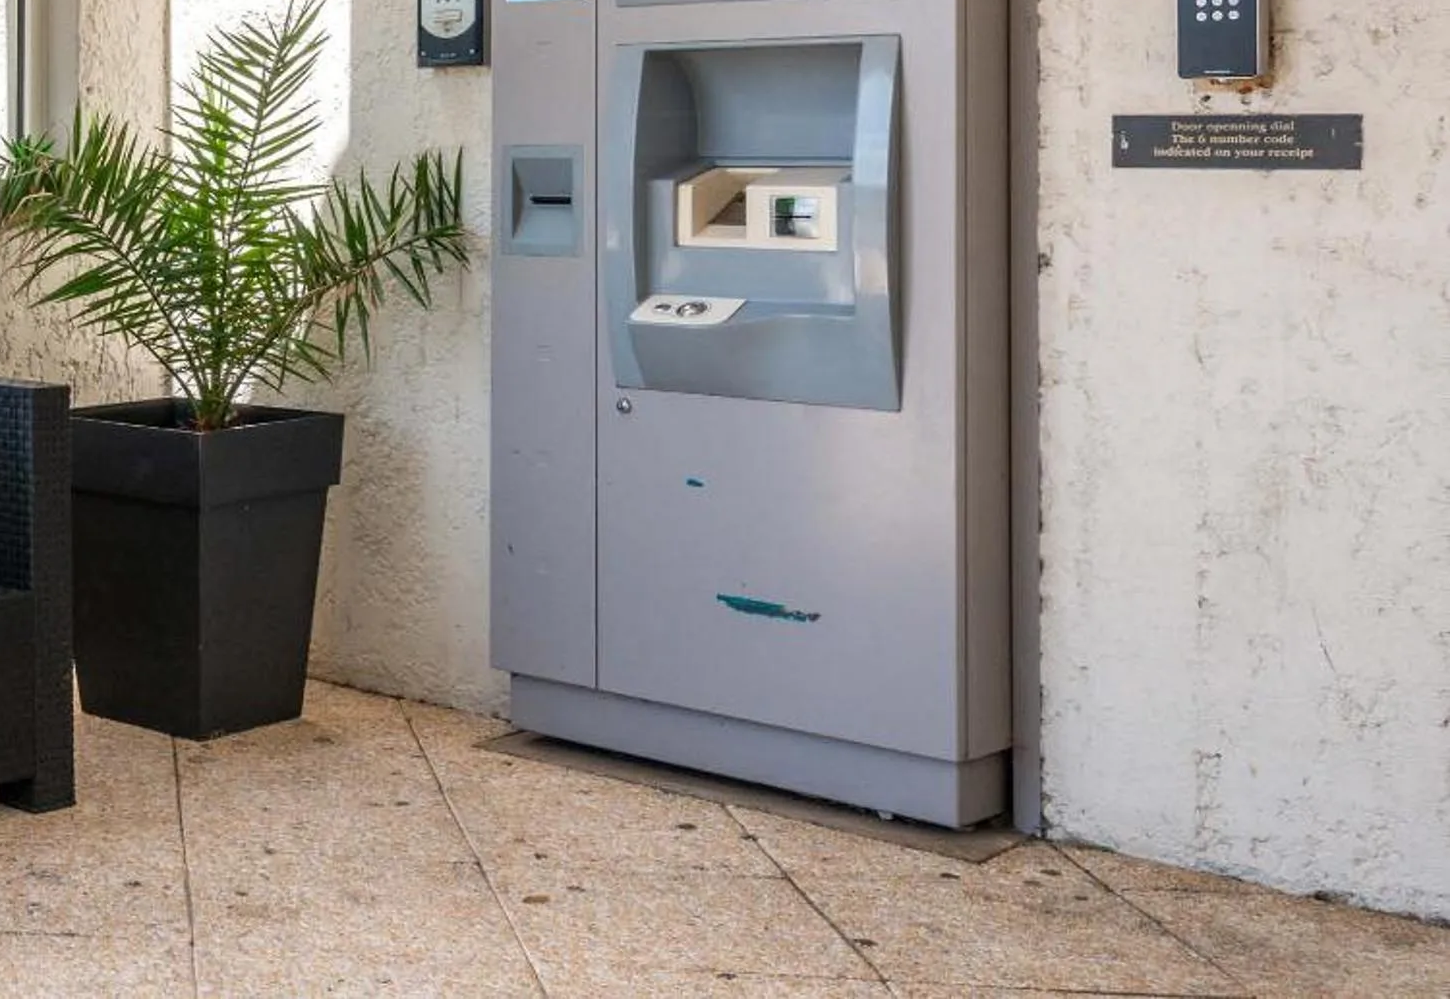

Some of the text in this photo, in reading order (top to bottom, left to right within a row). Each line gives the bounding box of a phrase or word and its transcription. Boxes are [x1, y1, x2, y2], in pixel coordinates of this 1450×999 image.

[1171, 121, 1202, 131] Door
[1270, 120, 1295, 131] dial
[1171, 134, 1294, 144] The 6 number code
[1153, 146, 1211, 157] indicated
[1234, 149, 1265, 159] your
[1268, 147, 1314, 159] receipt
